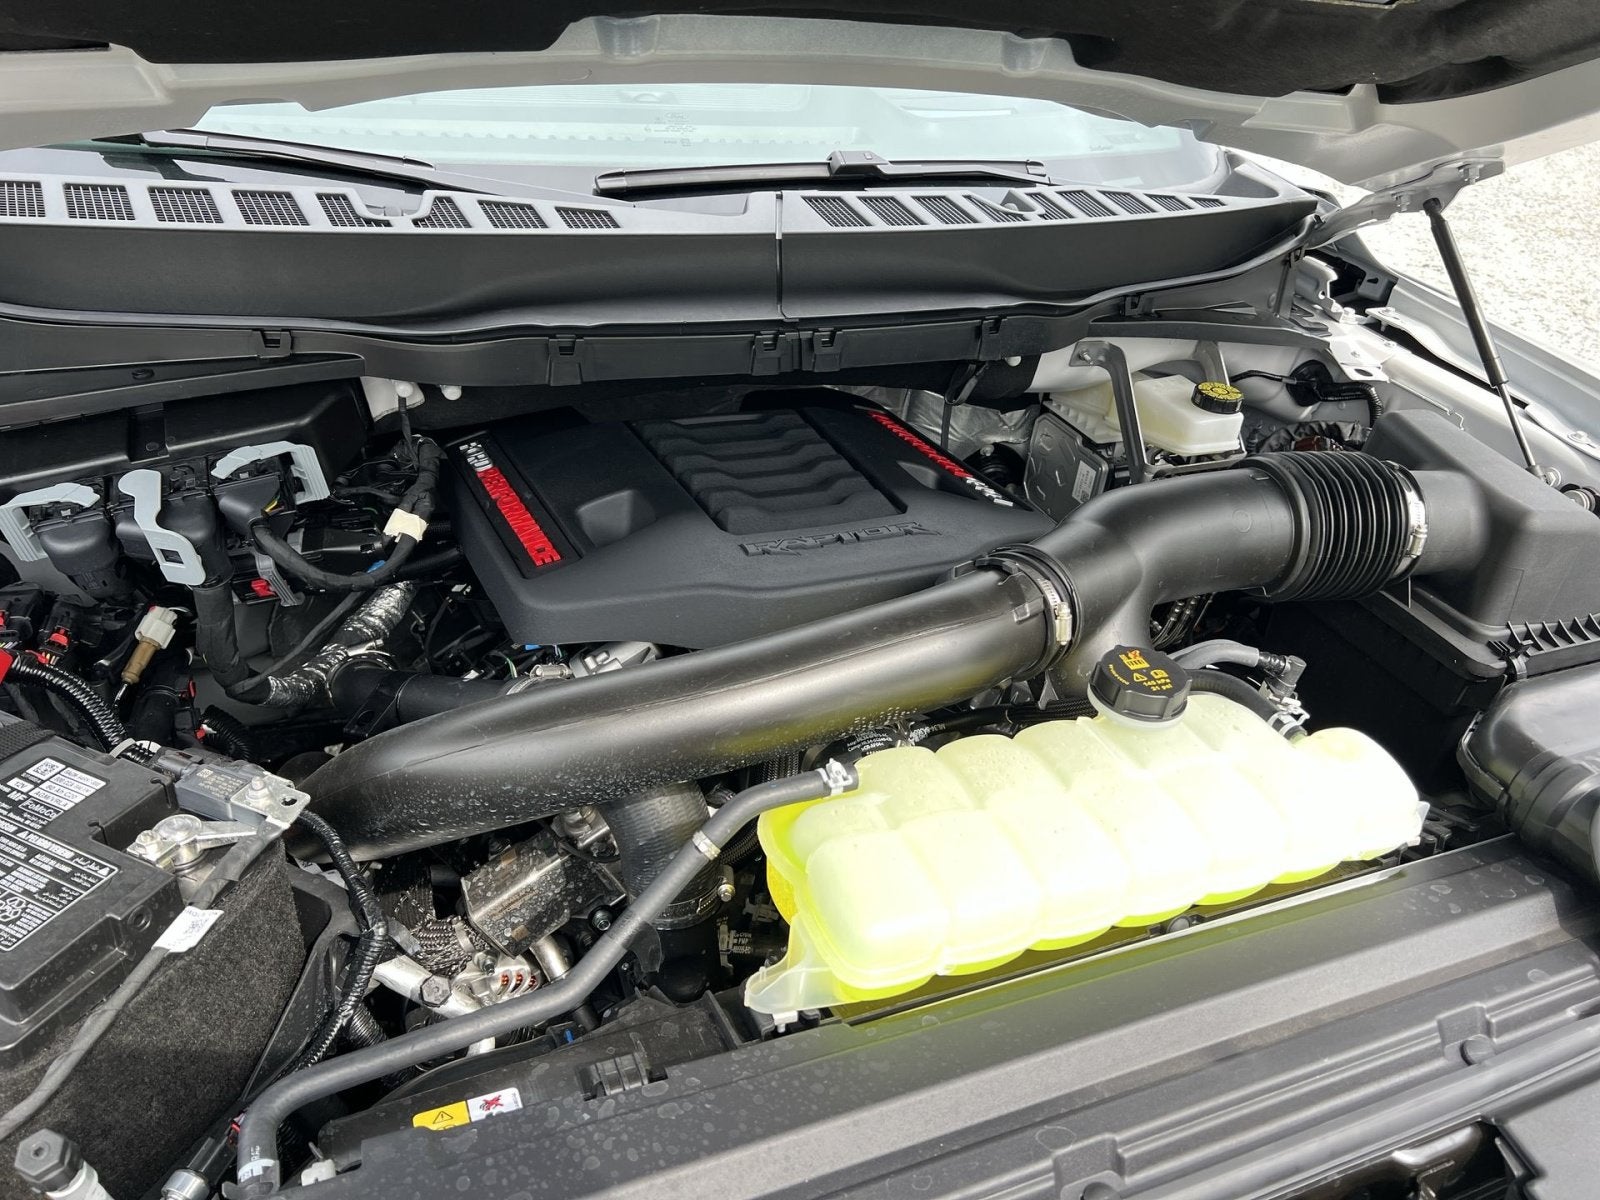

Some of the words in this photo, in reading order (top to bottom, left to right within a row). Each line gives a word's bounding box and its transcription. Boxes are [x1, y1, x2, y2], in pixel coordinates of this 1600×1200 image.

[477, 467, 561, 567] PERFORMANCE
[739, 521, 943, 557] RAPTOR
[22, 800, 56, 818] FoMoCo
